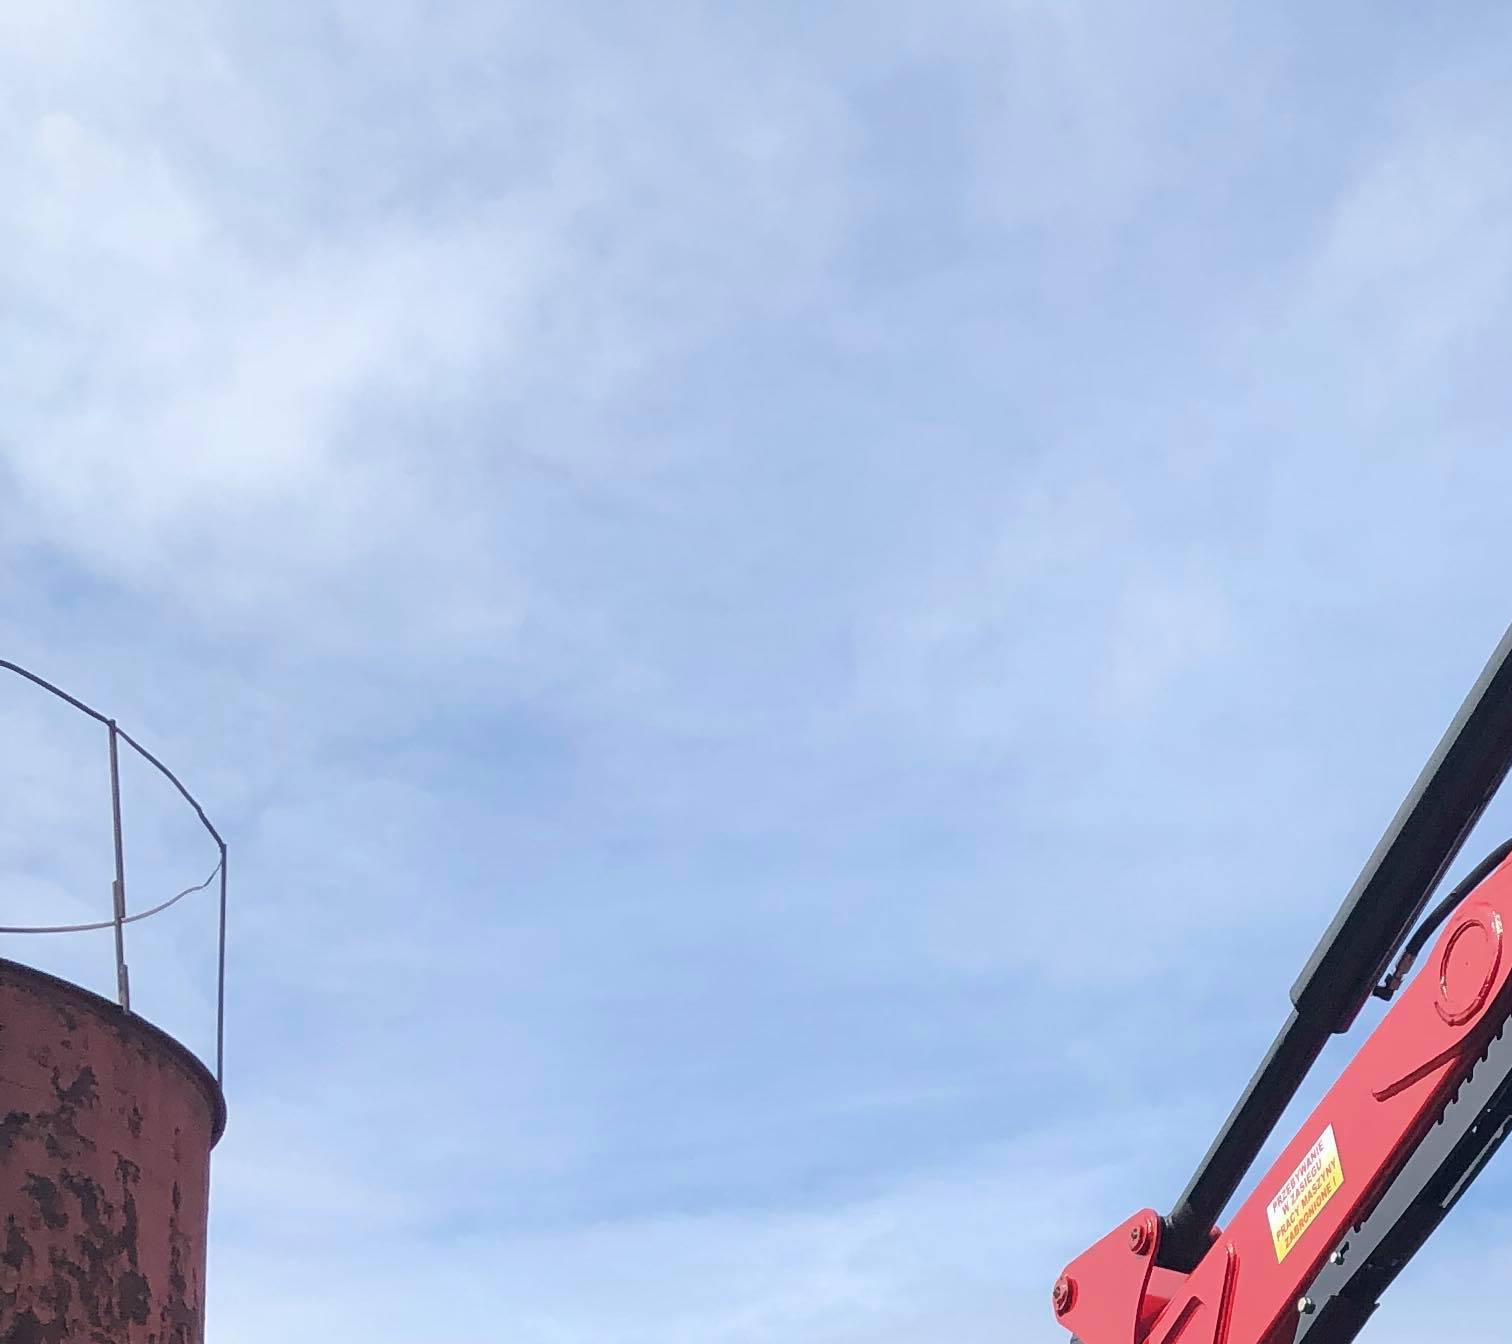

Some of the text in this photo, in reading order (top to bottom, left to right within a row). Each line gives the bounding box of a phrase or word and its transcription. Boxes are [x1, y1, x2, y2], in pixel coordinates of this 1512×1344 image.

[1272, 1139, 1324, 1213] PRZEBYWANIE
[1276, 1157, 1337, 1241] PRACY MASZYNY
